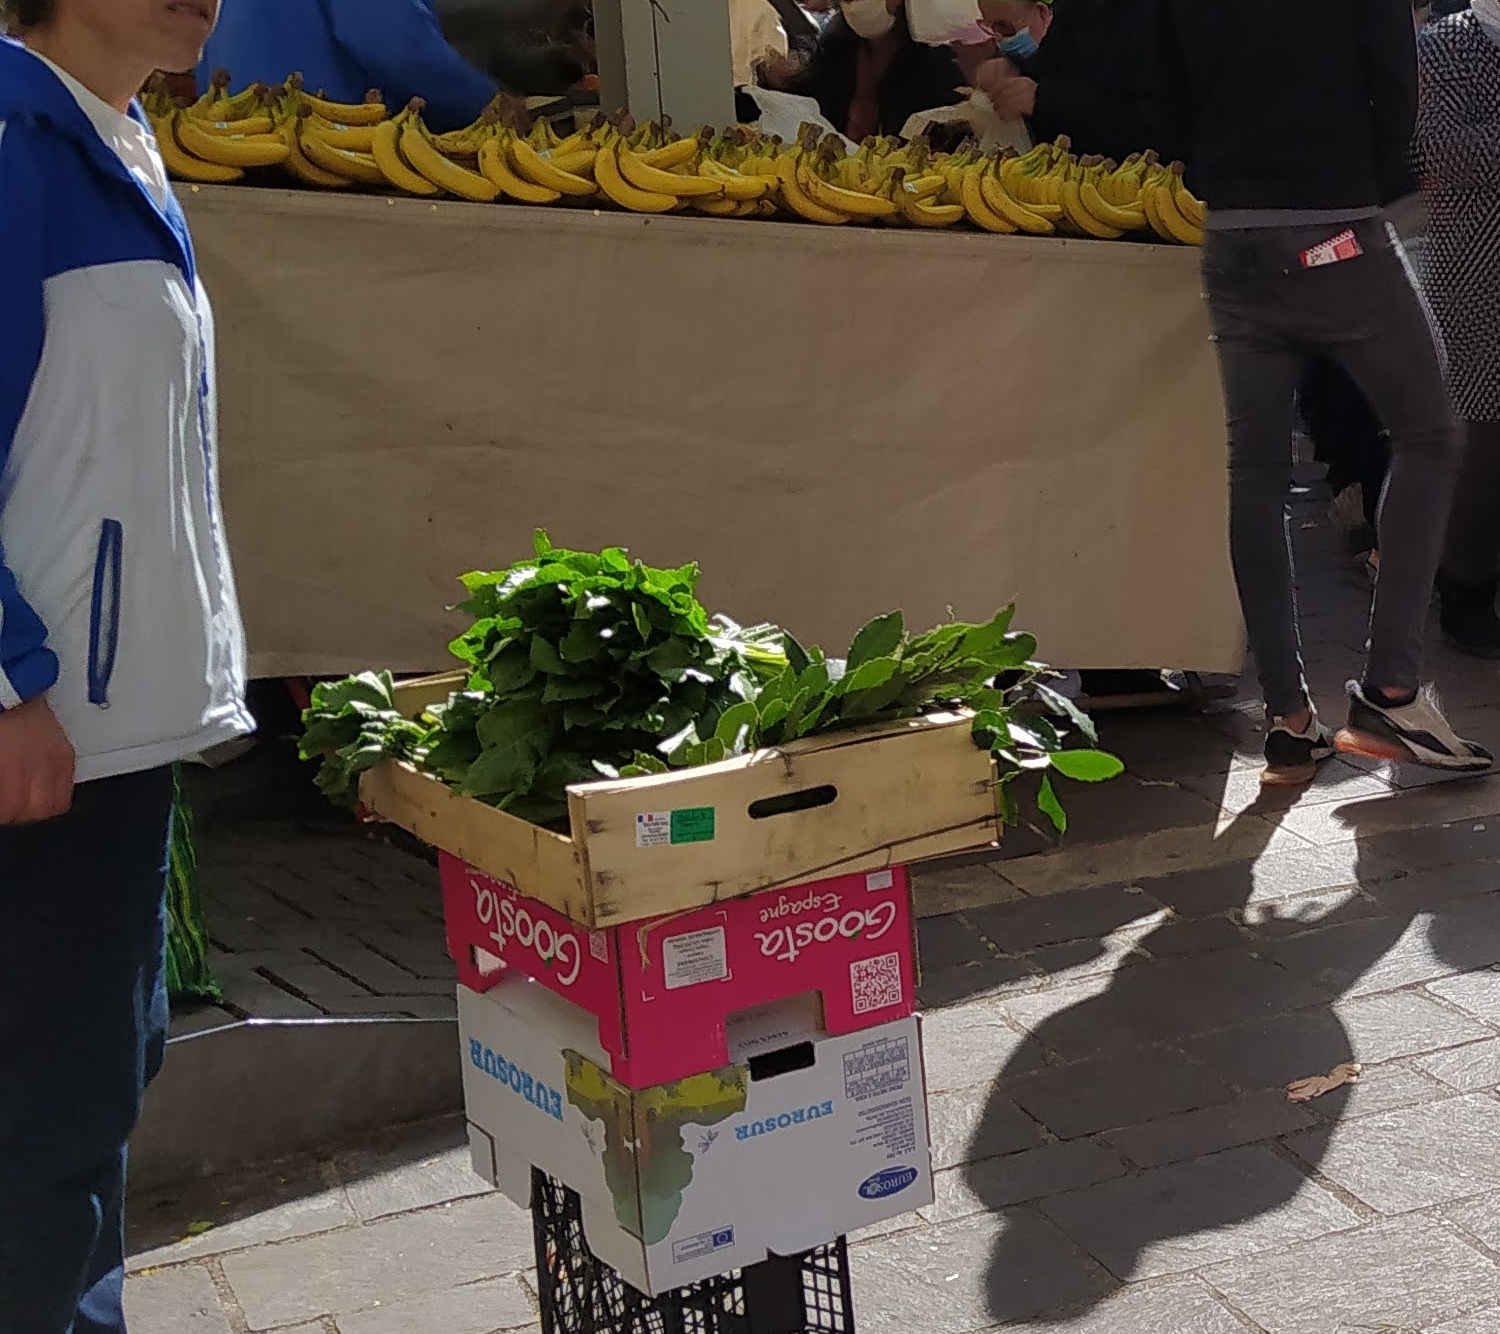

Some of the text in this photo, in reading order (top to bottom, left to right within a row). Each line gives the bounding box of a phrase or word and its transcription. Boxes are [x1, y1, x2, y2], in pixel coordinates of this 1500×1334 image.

[471, 879, 580, 985] Goosta
[754, 901, 896, 963] Goosta
[759, 890, 843, 923] Espagne
[469, 1036, 564, 1122] EUROSUR
[734, 1100, 833, 1142] EUROSUR
